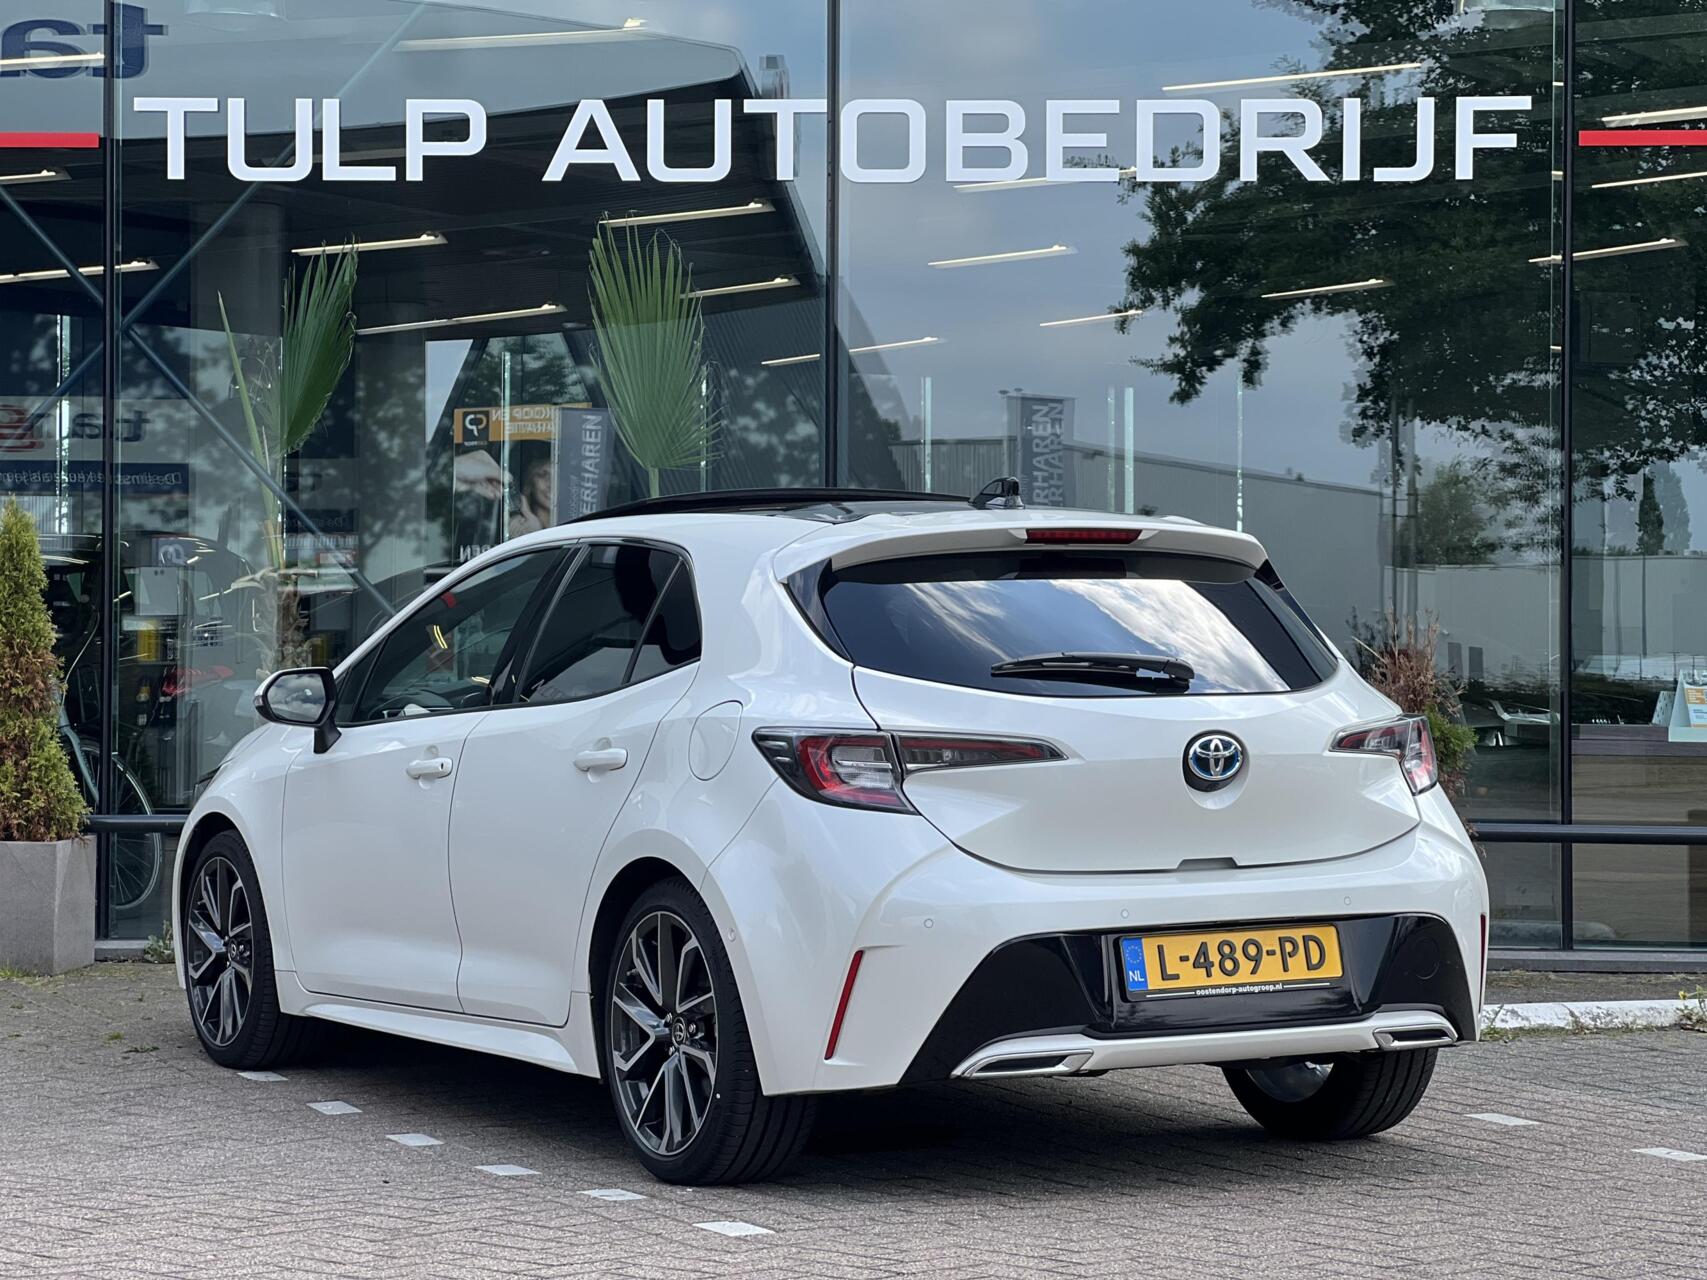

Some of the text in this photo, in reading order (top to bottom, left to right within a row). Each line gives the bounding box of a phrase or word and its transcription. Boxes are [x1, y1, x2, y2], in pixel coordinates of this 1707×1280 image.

[133, 95, 1532, 183] TULP AUTOBEDRIJF
[1128, 934, 1326, 983] NL L-489-PD
[1195, 982, 1283, 996] oostendorp-autogroep.nl
